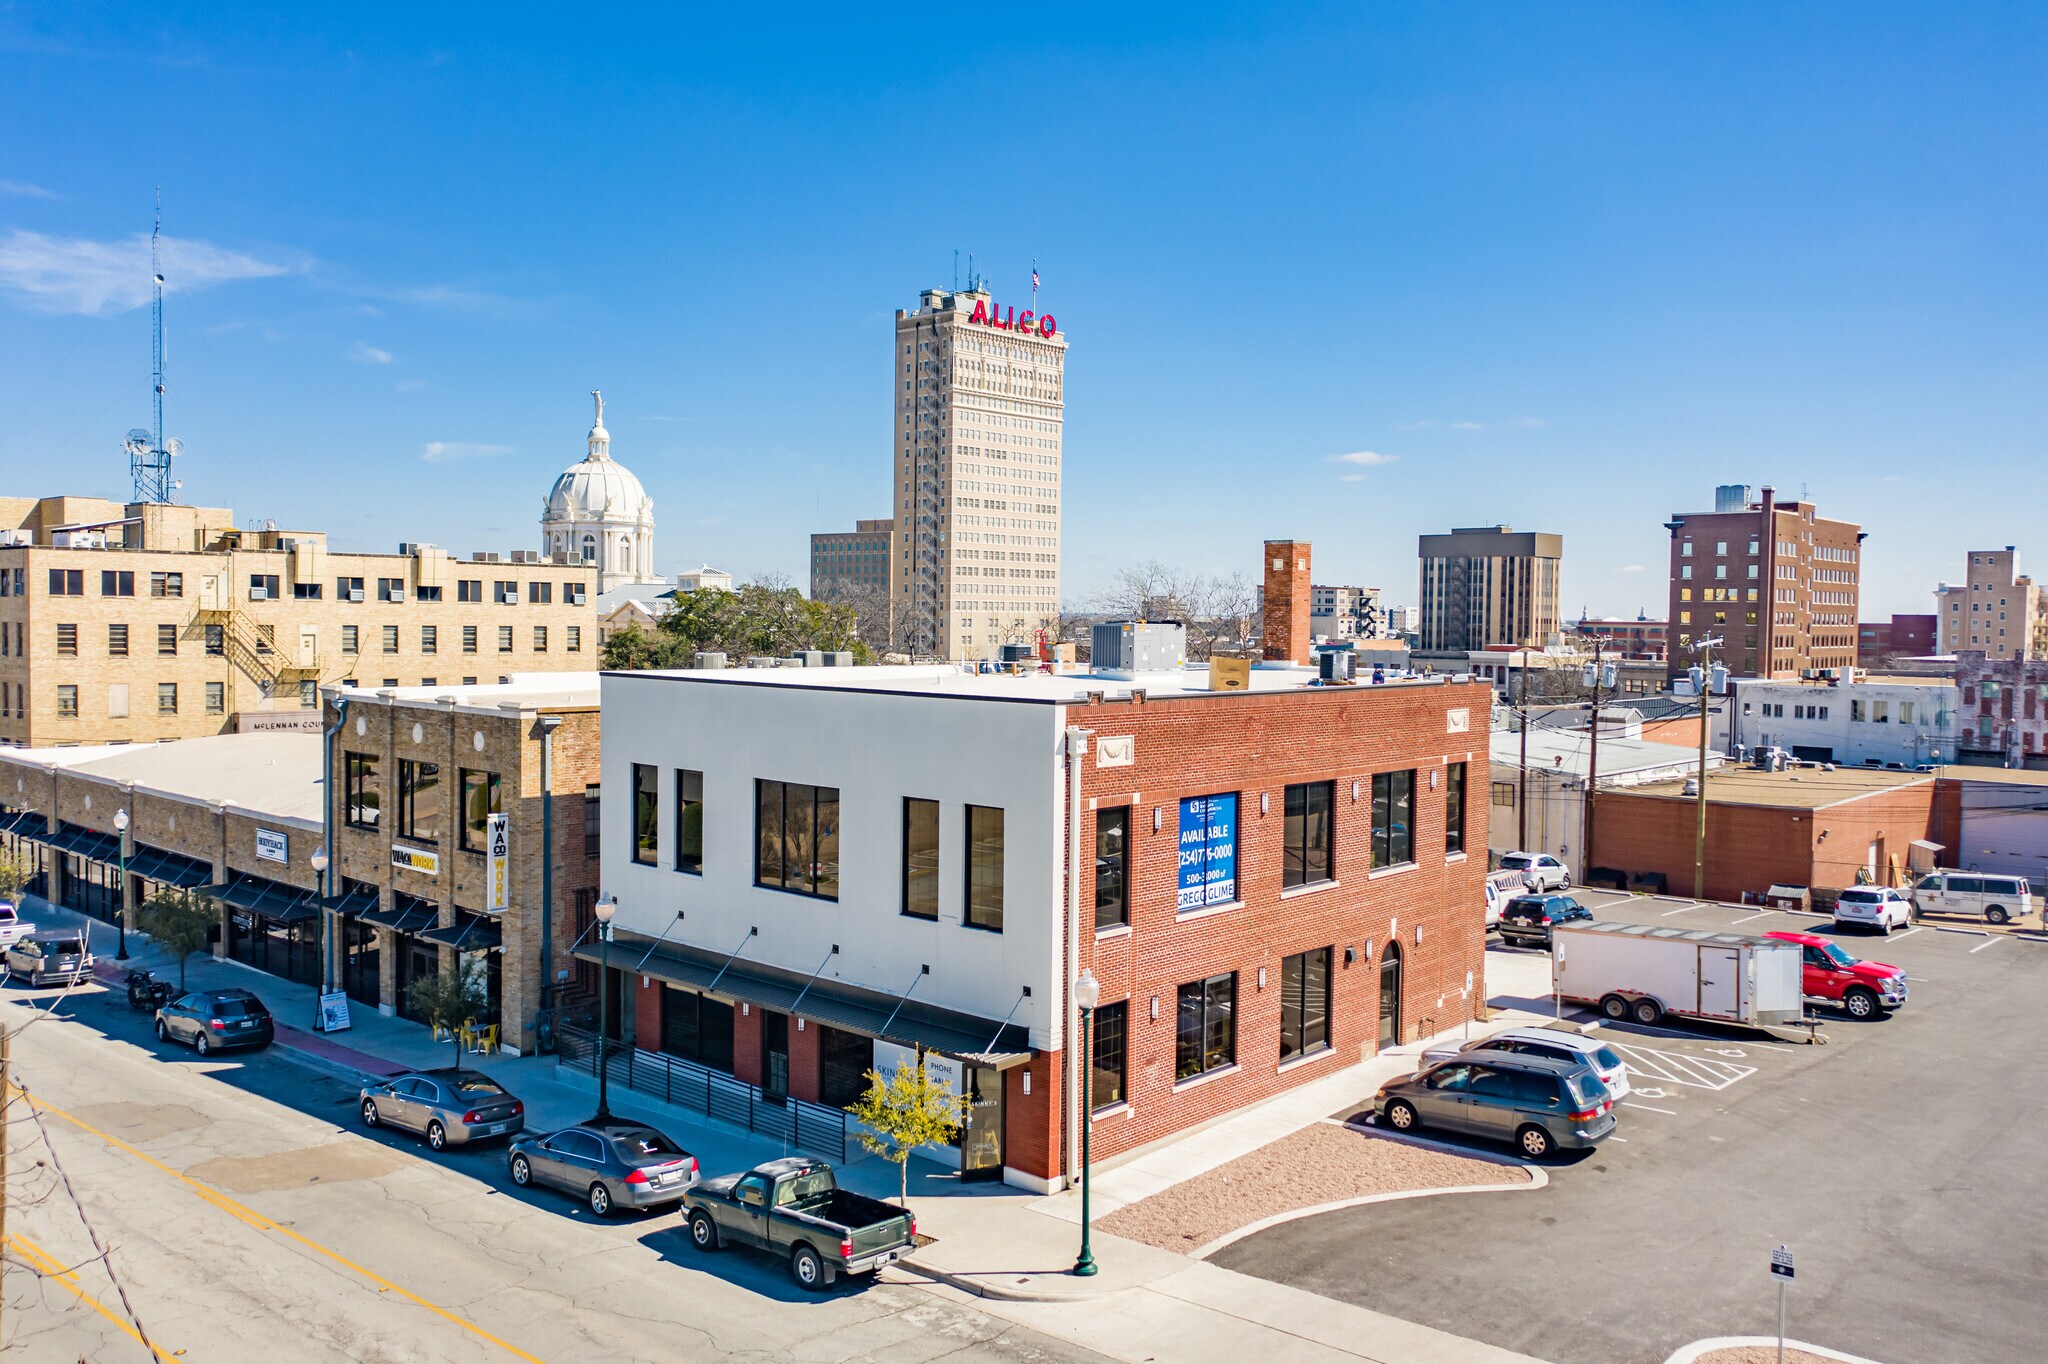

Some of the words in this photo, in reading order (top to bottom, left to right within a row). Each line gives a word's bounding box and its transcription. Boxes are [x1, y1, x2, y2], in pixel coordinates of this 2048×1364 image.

[971, 299, 1057, 339] ALICO
[1180, 824, 1229, 845] AVAILABLE
[1178, 843, 1233, 869] (254)776-0000
[1207, 883, 1234, 900] GLIME
[877, 1064, 898, 1078] SKIN
[930, 1061, 953, 1075] PHONE
